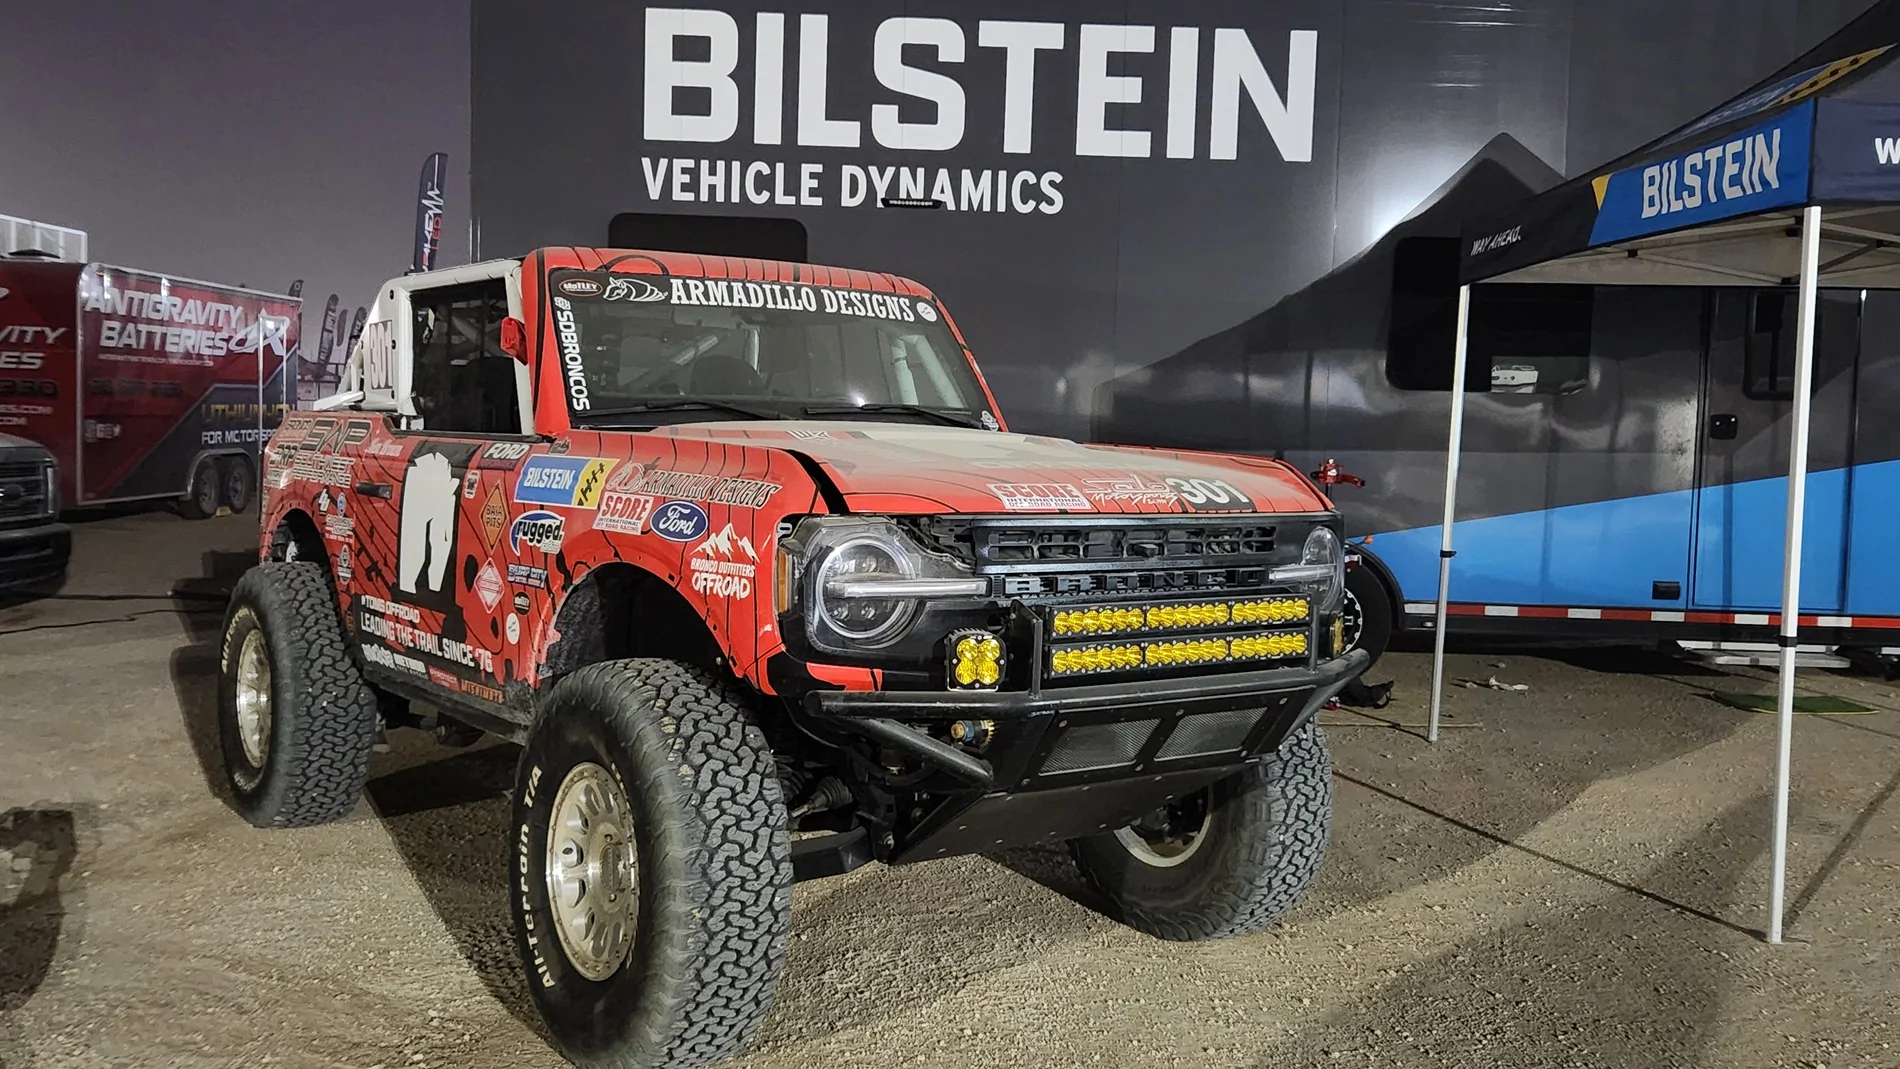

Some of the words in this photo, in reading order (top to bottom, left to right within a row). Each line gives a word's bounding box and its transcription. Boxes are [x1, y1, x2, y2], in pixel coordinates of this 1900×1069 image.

[643, 7, 1318, 162] BILSTEIN
[641, 157, 823, 206] VEHICLE
[840, 165, 1064, 215] DYNAMICS
[1641, 128, 1781, 219] BILSTEIN
[1471, 236, 1490, 256] WAY
[1489, 224, 1521, 250] AHEAD.
[84, 287, 244, 328] ANTIGRAVITY
[670, 278, 817, 312] ARMADILLO
[820, 289, 916, 322] DESIGNS
[100, 320, 228, 356] BATTERIES
[370, 321, 392, 389] 301
[202, 430, 223, 445] FOR
[484, 442, 530, 460] FORD
[523, 467, 575, 490] BILSTEIN
[643, 470, 716, 500] ARMADILLO
[711, 478, 780, 508] DESIGNS
[996, 484, 1078, 498] SCORE
[1164, 478, 1250, 504] 301
[486, 515, 501, 528] PITS
[601, 495, 650, 520] SCORE
[659, 505, 696, 535] Ford
[690, 557, 718, 573] BRONCO
[718, 561, 755, 578] OUTFITTERS
[691, 572, 750, 600] OFFROAD
[361, 612, 395, 640] LEADING
[395, 622, 415, 647] THE
[413, 628, 443, 657] TRAIL
[442, 638, 475, 667] SINCE
